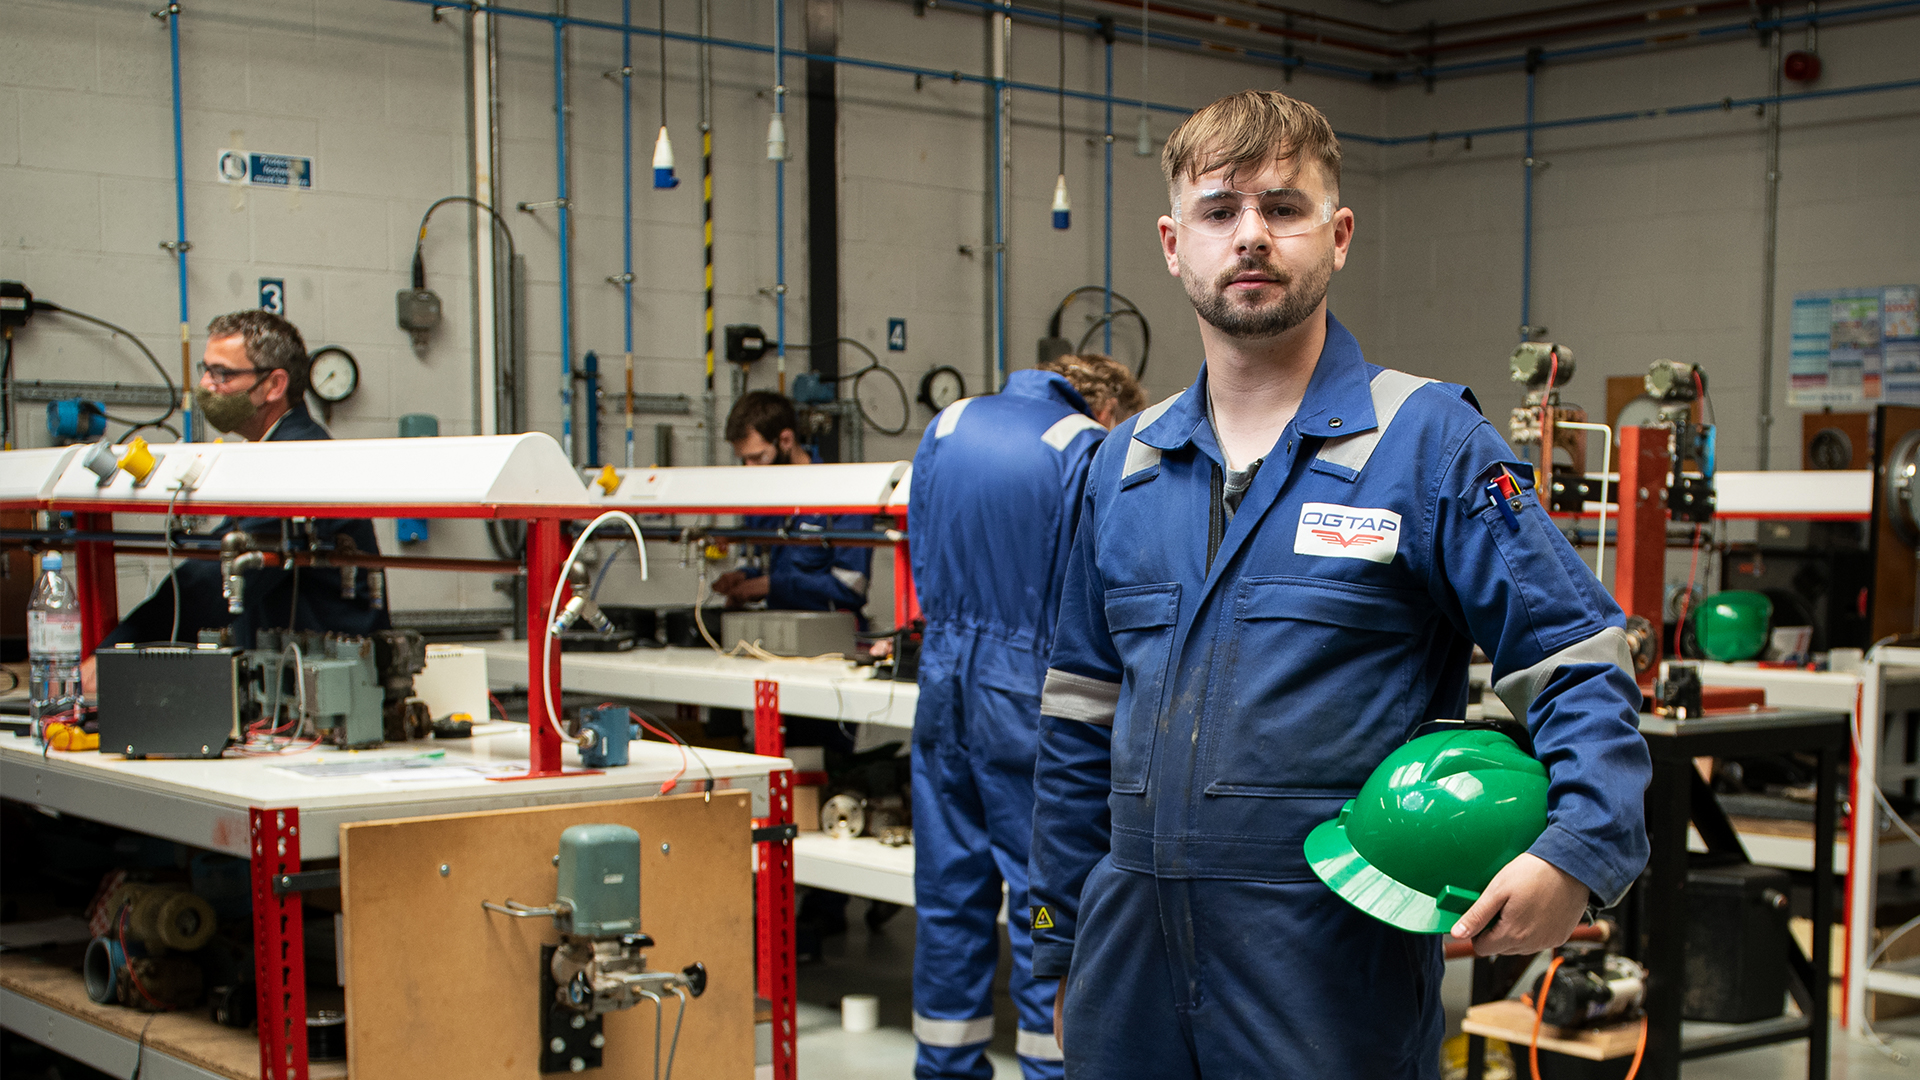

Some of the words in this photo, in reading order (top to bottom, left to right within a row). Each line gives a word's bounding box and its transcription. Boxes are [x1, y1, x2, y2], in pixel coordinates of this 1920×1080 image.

[261, 283, 283, 315] 3
[890, 323, 903, 348] 4
[1302, 511, 1398, 532] OGTAP
